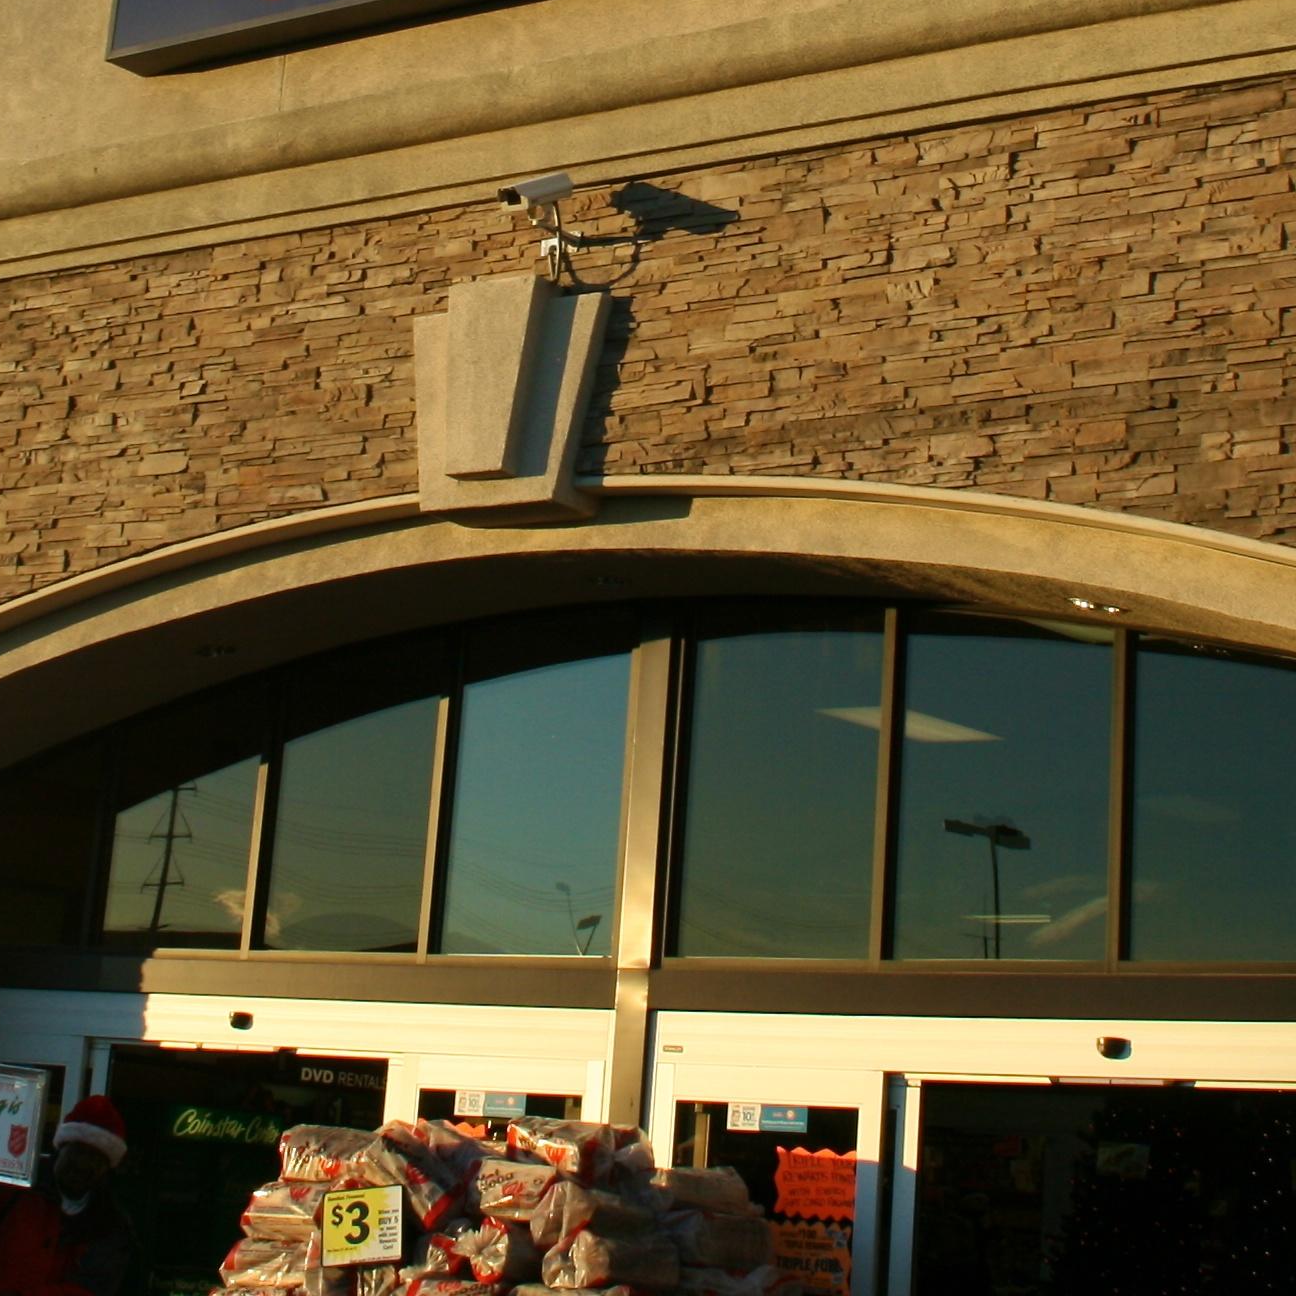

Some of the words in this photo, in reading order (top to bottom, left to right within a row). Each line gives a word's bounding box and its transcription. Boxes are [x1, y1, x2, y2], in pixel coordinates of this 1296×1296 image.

[301, 1067, 334, 1084] DVD
[8, 1095, 24, 1116] is
[172, 1107, 246, 1139] Coinstar
[331, 1201, 371, 1244] $3
